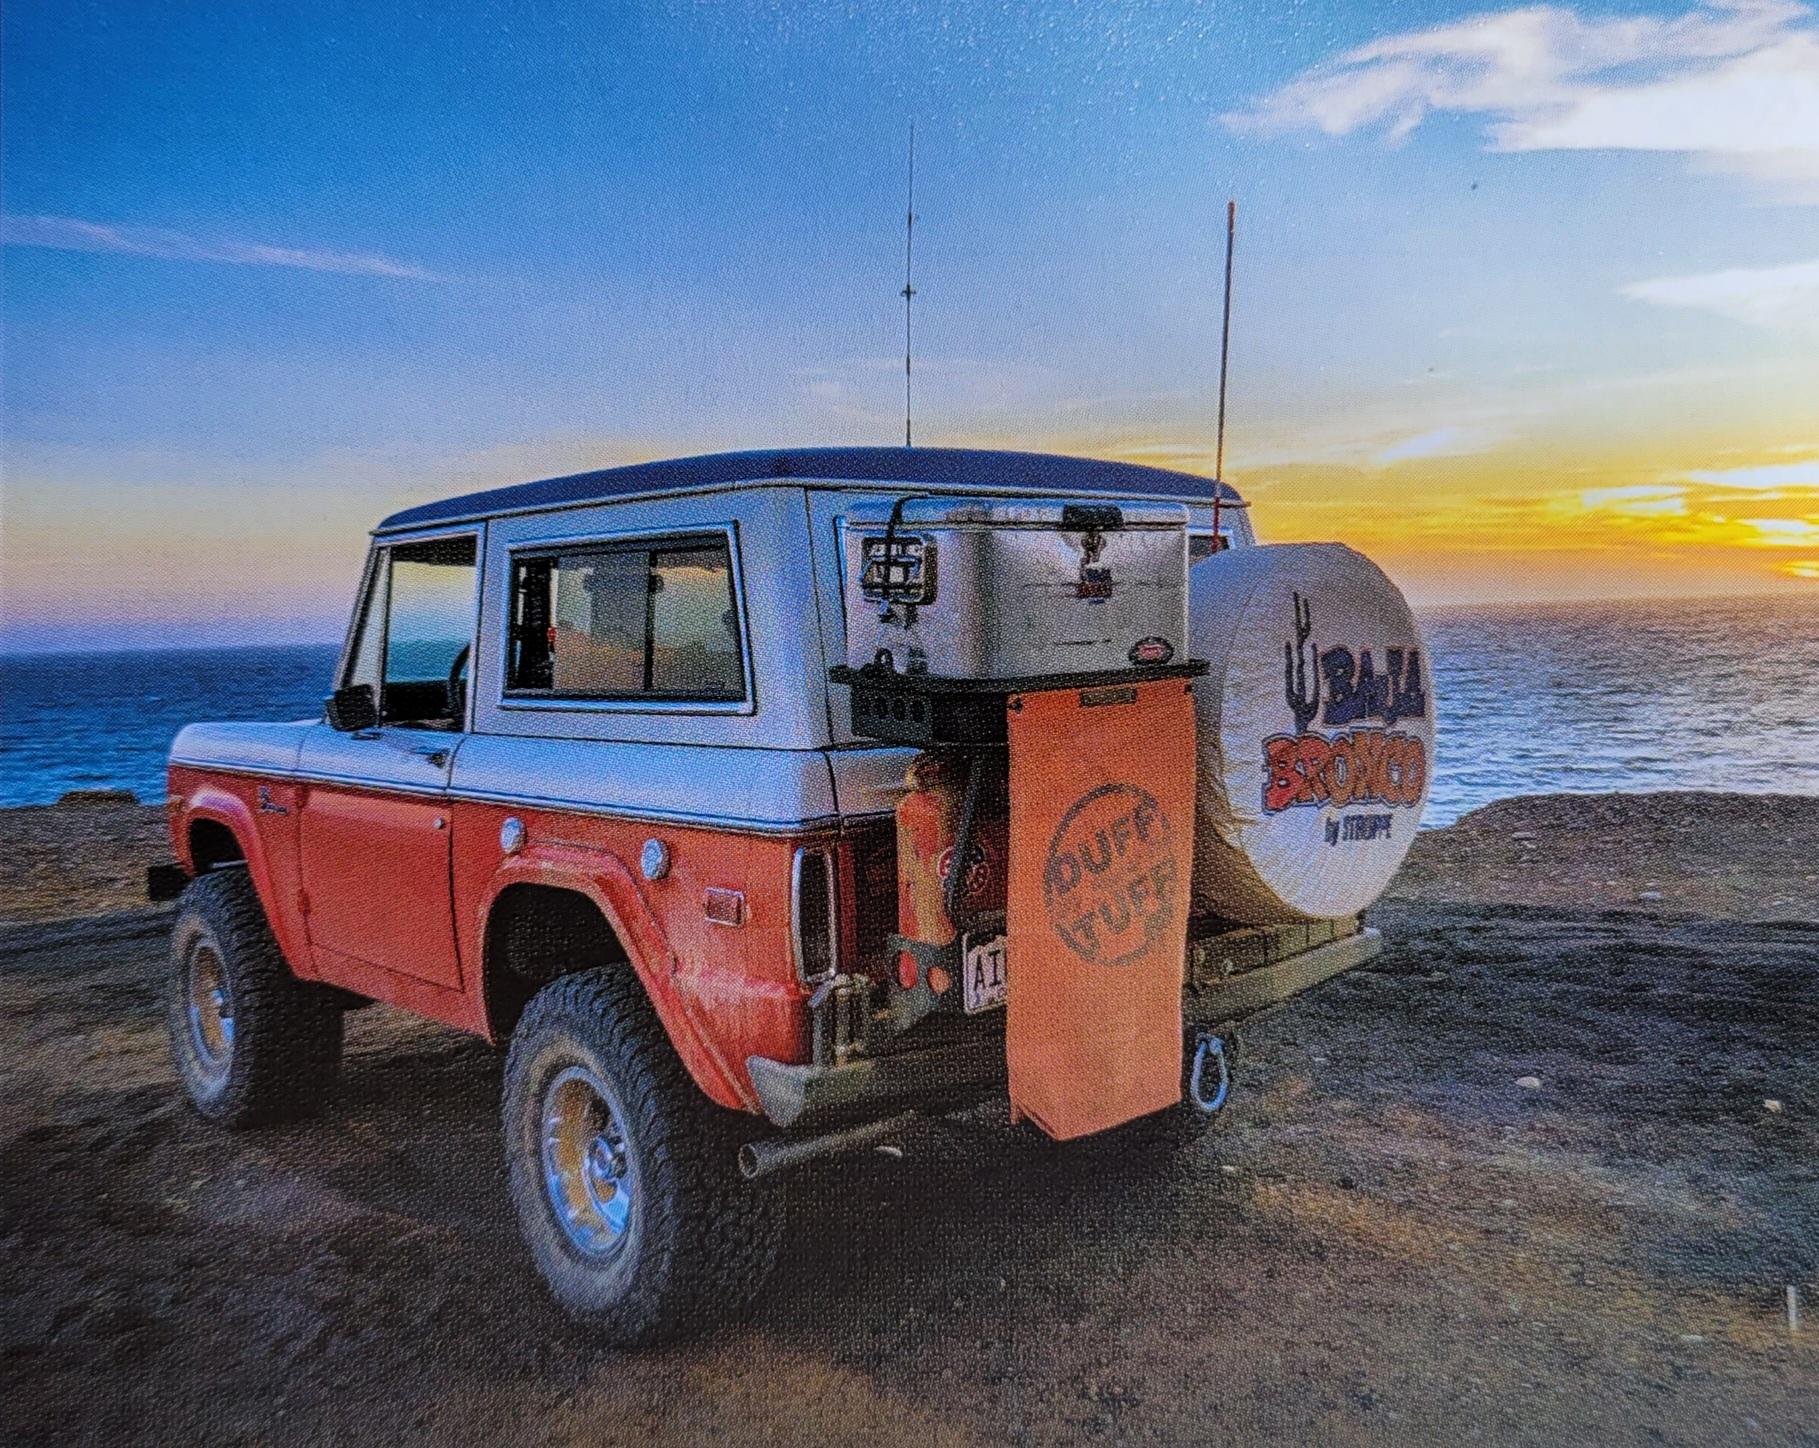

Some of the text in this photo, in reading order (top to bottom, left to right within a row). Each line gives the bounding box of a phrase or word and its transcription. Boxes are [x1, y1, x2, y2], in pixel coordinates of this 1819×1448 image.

[1320, 647, 1425, 726] BAJA
[1262, 732, 1427, 815] BRONCO
[1050, 802, 1159, 896] DUFF
[1071, 854, 1177, 956] TUFF
